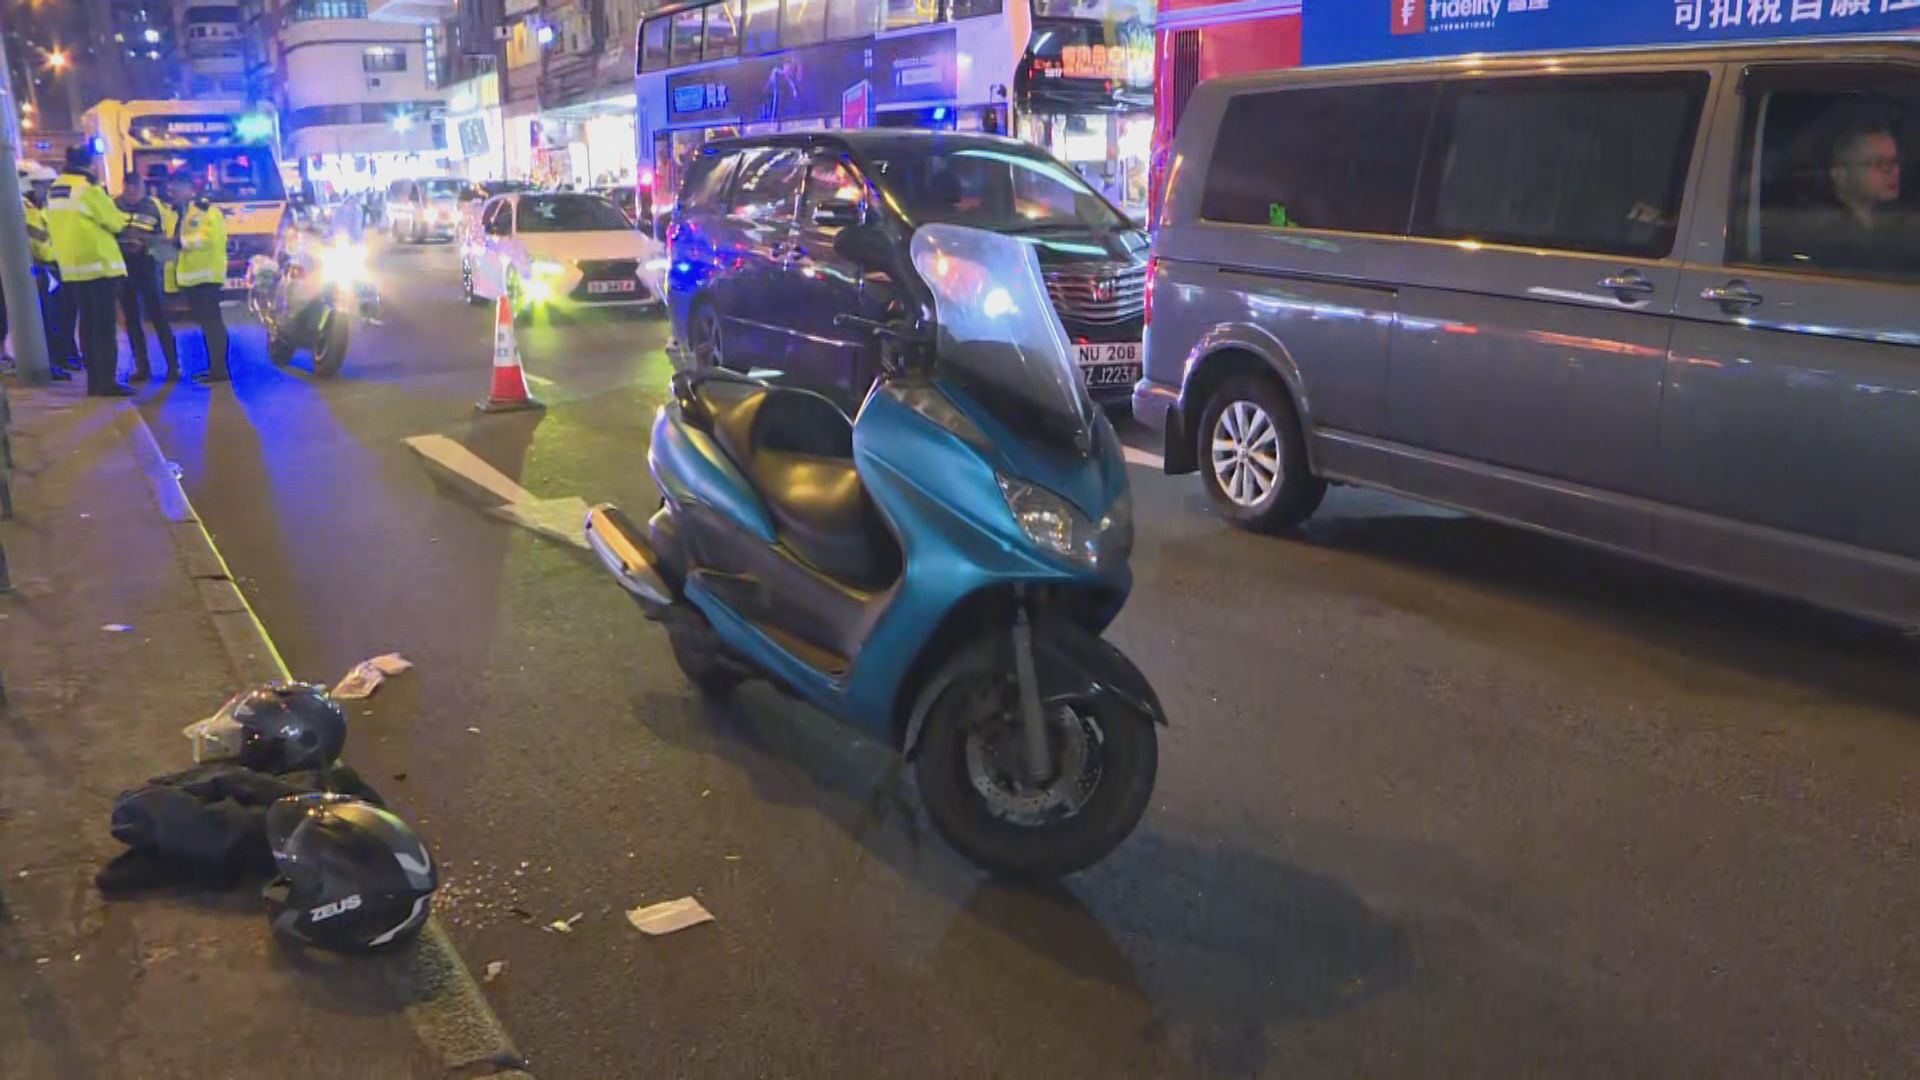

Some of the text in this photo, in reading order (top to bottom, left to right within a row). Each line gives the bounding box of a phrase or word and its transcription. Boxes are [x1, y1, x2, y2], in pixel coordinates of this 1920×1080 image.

[1430, 0, 1501, 19] Fidelity
[1079, 346, 1100, 361] NU
[311, 894, 362, 922] ZEUS
